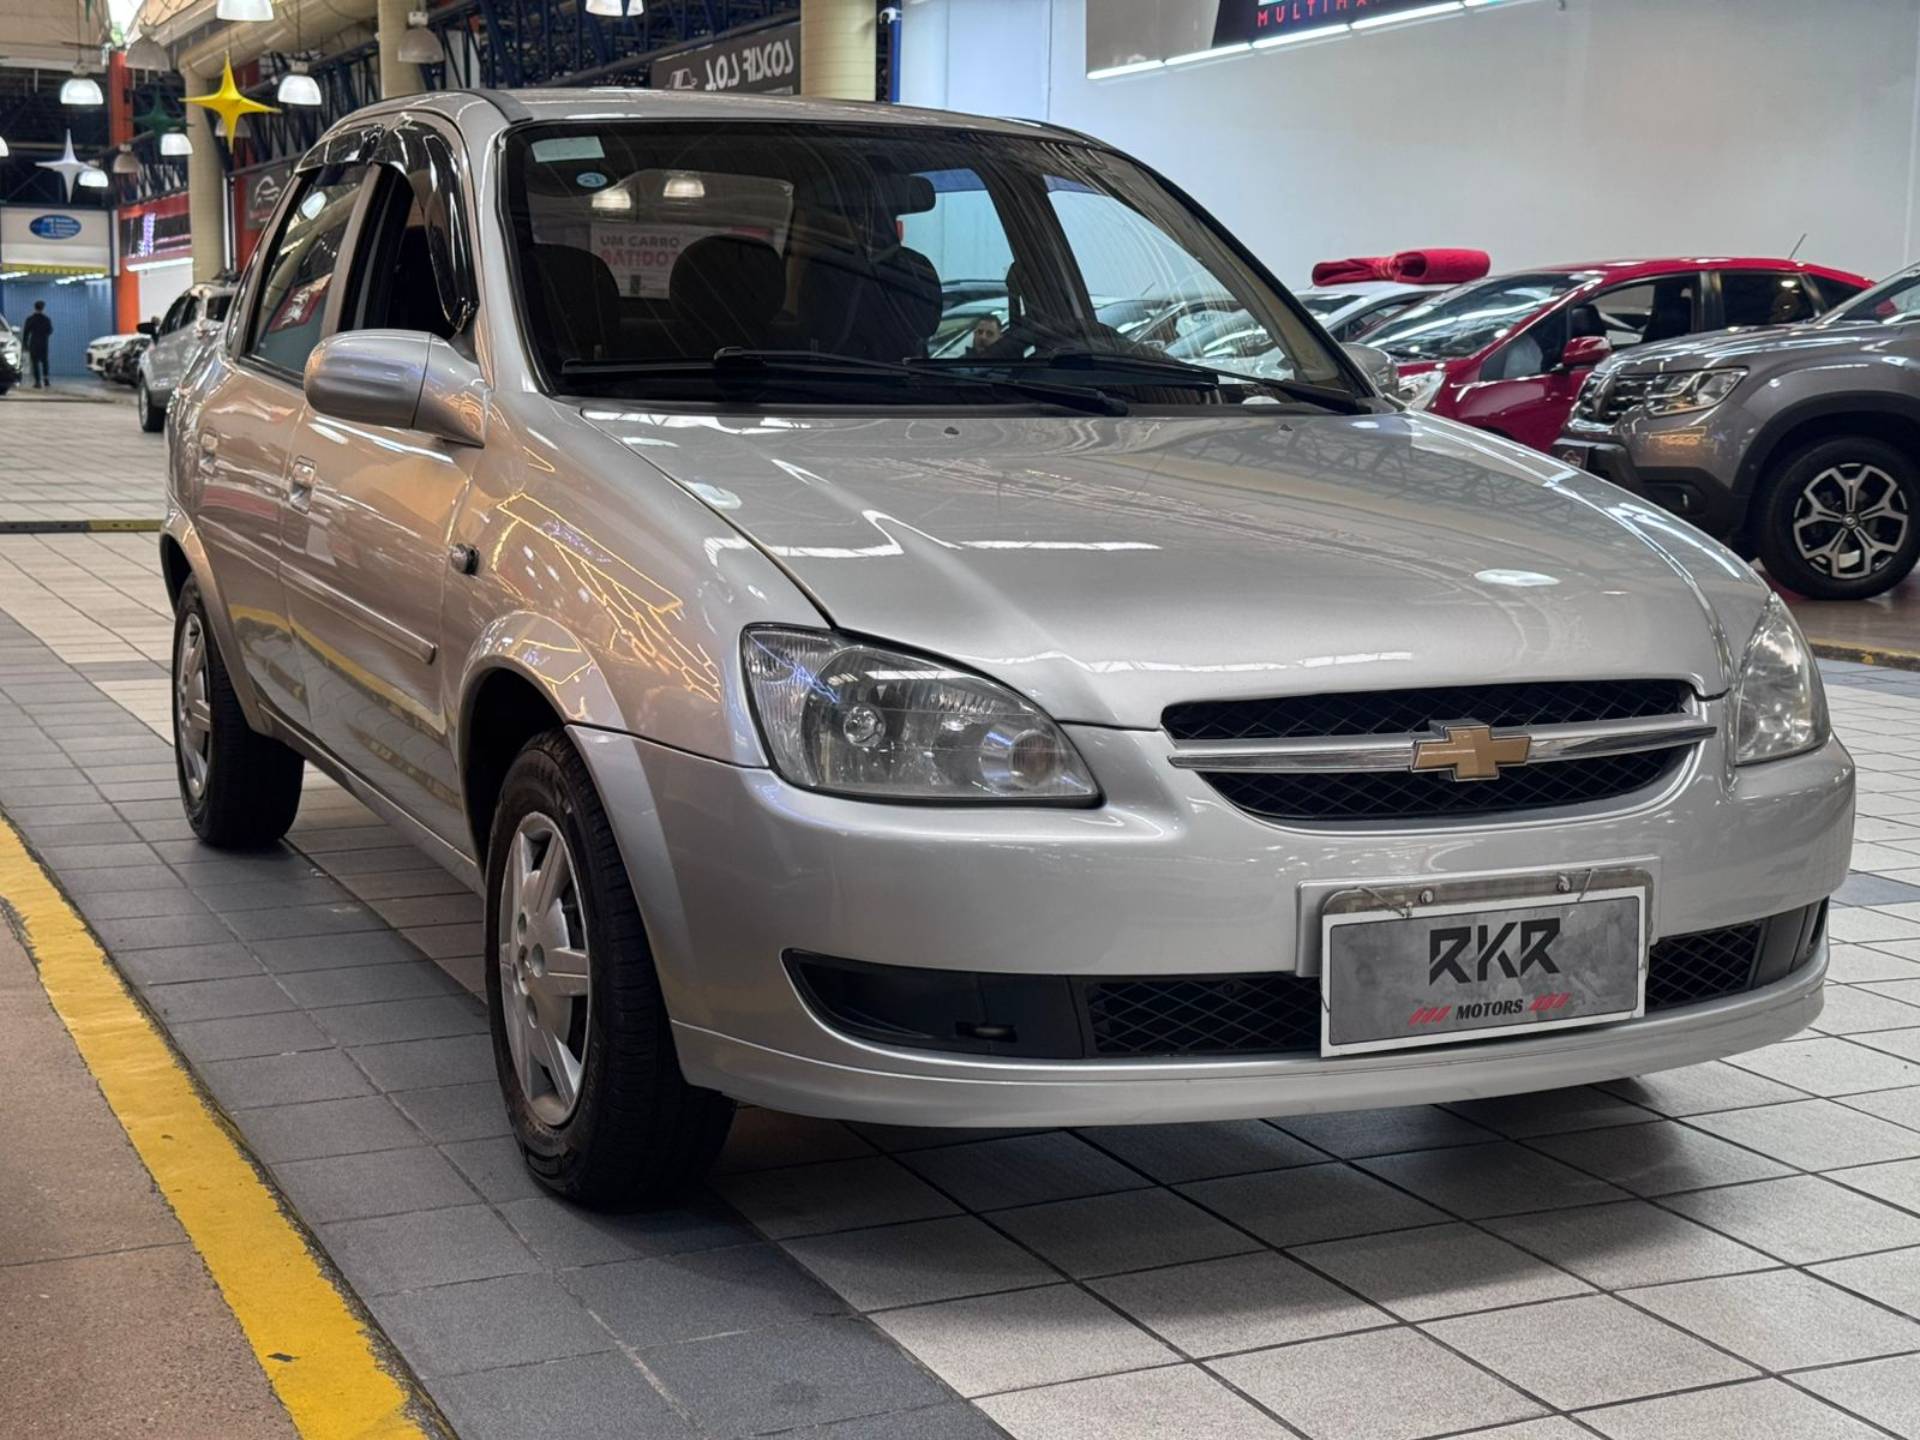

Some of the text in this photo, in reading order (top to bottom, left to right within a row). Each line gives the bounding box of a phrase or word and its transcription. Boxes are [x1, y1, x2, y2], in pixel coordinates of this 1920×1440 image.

[600, 235, 680, 248] UM CARRO
[1429, 917, 1561, 986] RKR
[1455, 998, 1524, 1021] MOTORS
